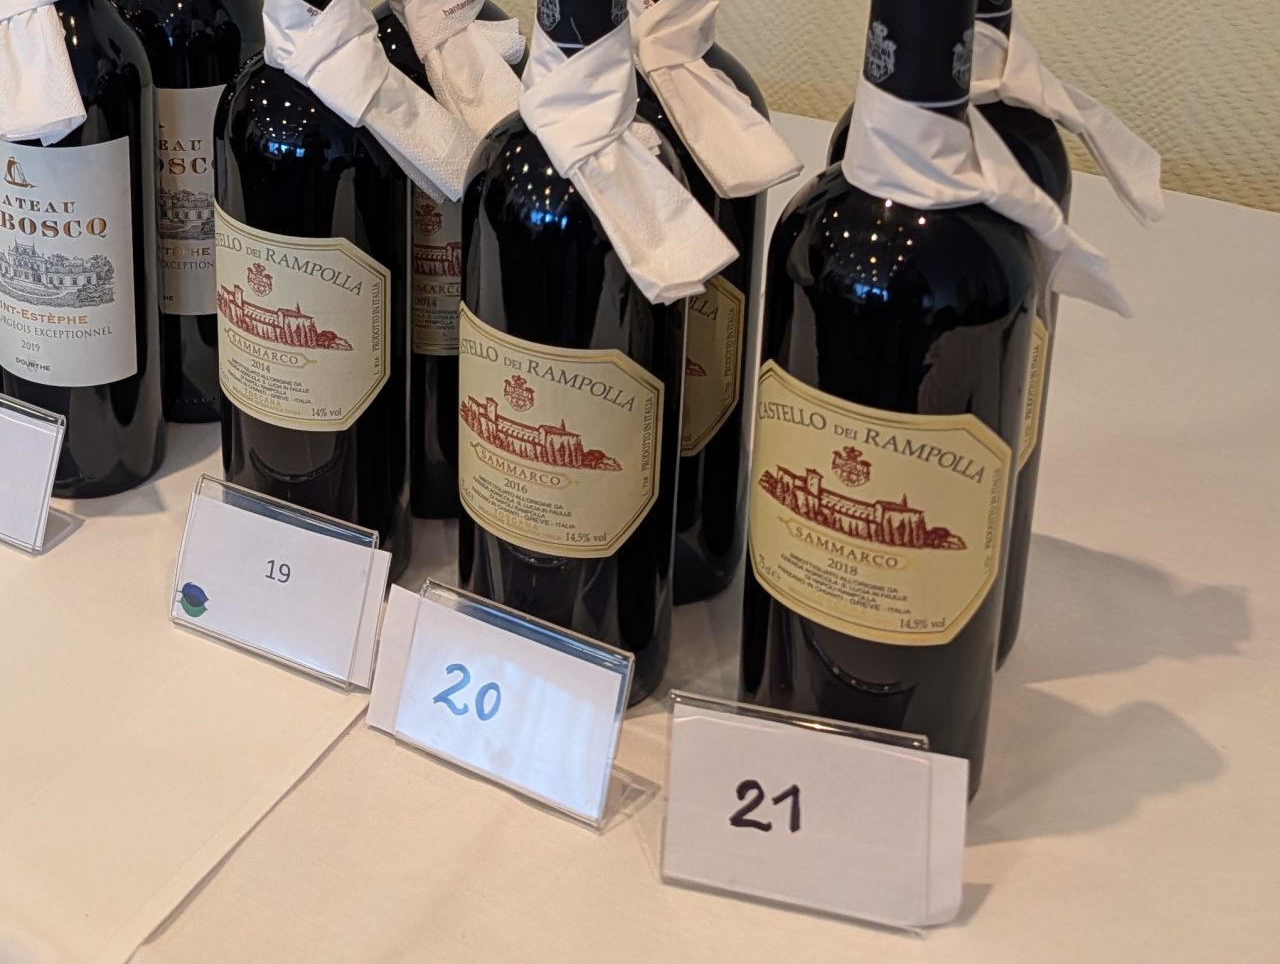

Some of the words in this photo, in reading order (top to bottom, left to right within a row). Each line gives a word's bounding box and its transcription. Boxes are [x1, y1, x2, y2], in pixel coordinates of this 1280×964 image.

[0, 209, 107, 238] BOSCQ
[246, 246, 262, 259] DEI
[265, 247, 363, 296] RAMPOLLA
[372, 282, 380, 305] ITALIA
[35, 326, 112, 339] EXCEPTIONNEL
[372, 315, 381, 352] PRODOTTO
[21, 339, 40, 352] 2019
[232, 333, 298, 365] SAMMARCO
[15, 356, 51, 371] DOURTHE
[251, 358, 270, 373] 2014
[503, 355, 521, 370] DEI
[527, 358, 636, 412] RAMPOLLA
[311, 407, 327, 417] 14%
[330, 407, 342, 416] vol
[645, 397, 654, 422] ITALIA
[641, 433, 653, 472] PRODOTTO
[833, 424, 858, 440] DEI
[864, 429, 986, 485] RAMPOLLA
[481, 449, 560, 486] SAMMARCO
[504, 477, 528, 494] 2016
[524, 515, 550, 526] GREVE
[593, 532, 607, 542] vol
[795, 525, 899, 569] SAMMARCO
[264, 559, 291, 583] 19
[827, 557, 858, 577] 2018
[849, 597, 881, 612] GREVE
[931, 617, 946, 628] vol
[433, 663, 502, 721] 20
[729, 779, 801, 833] 21
